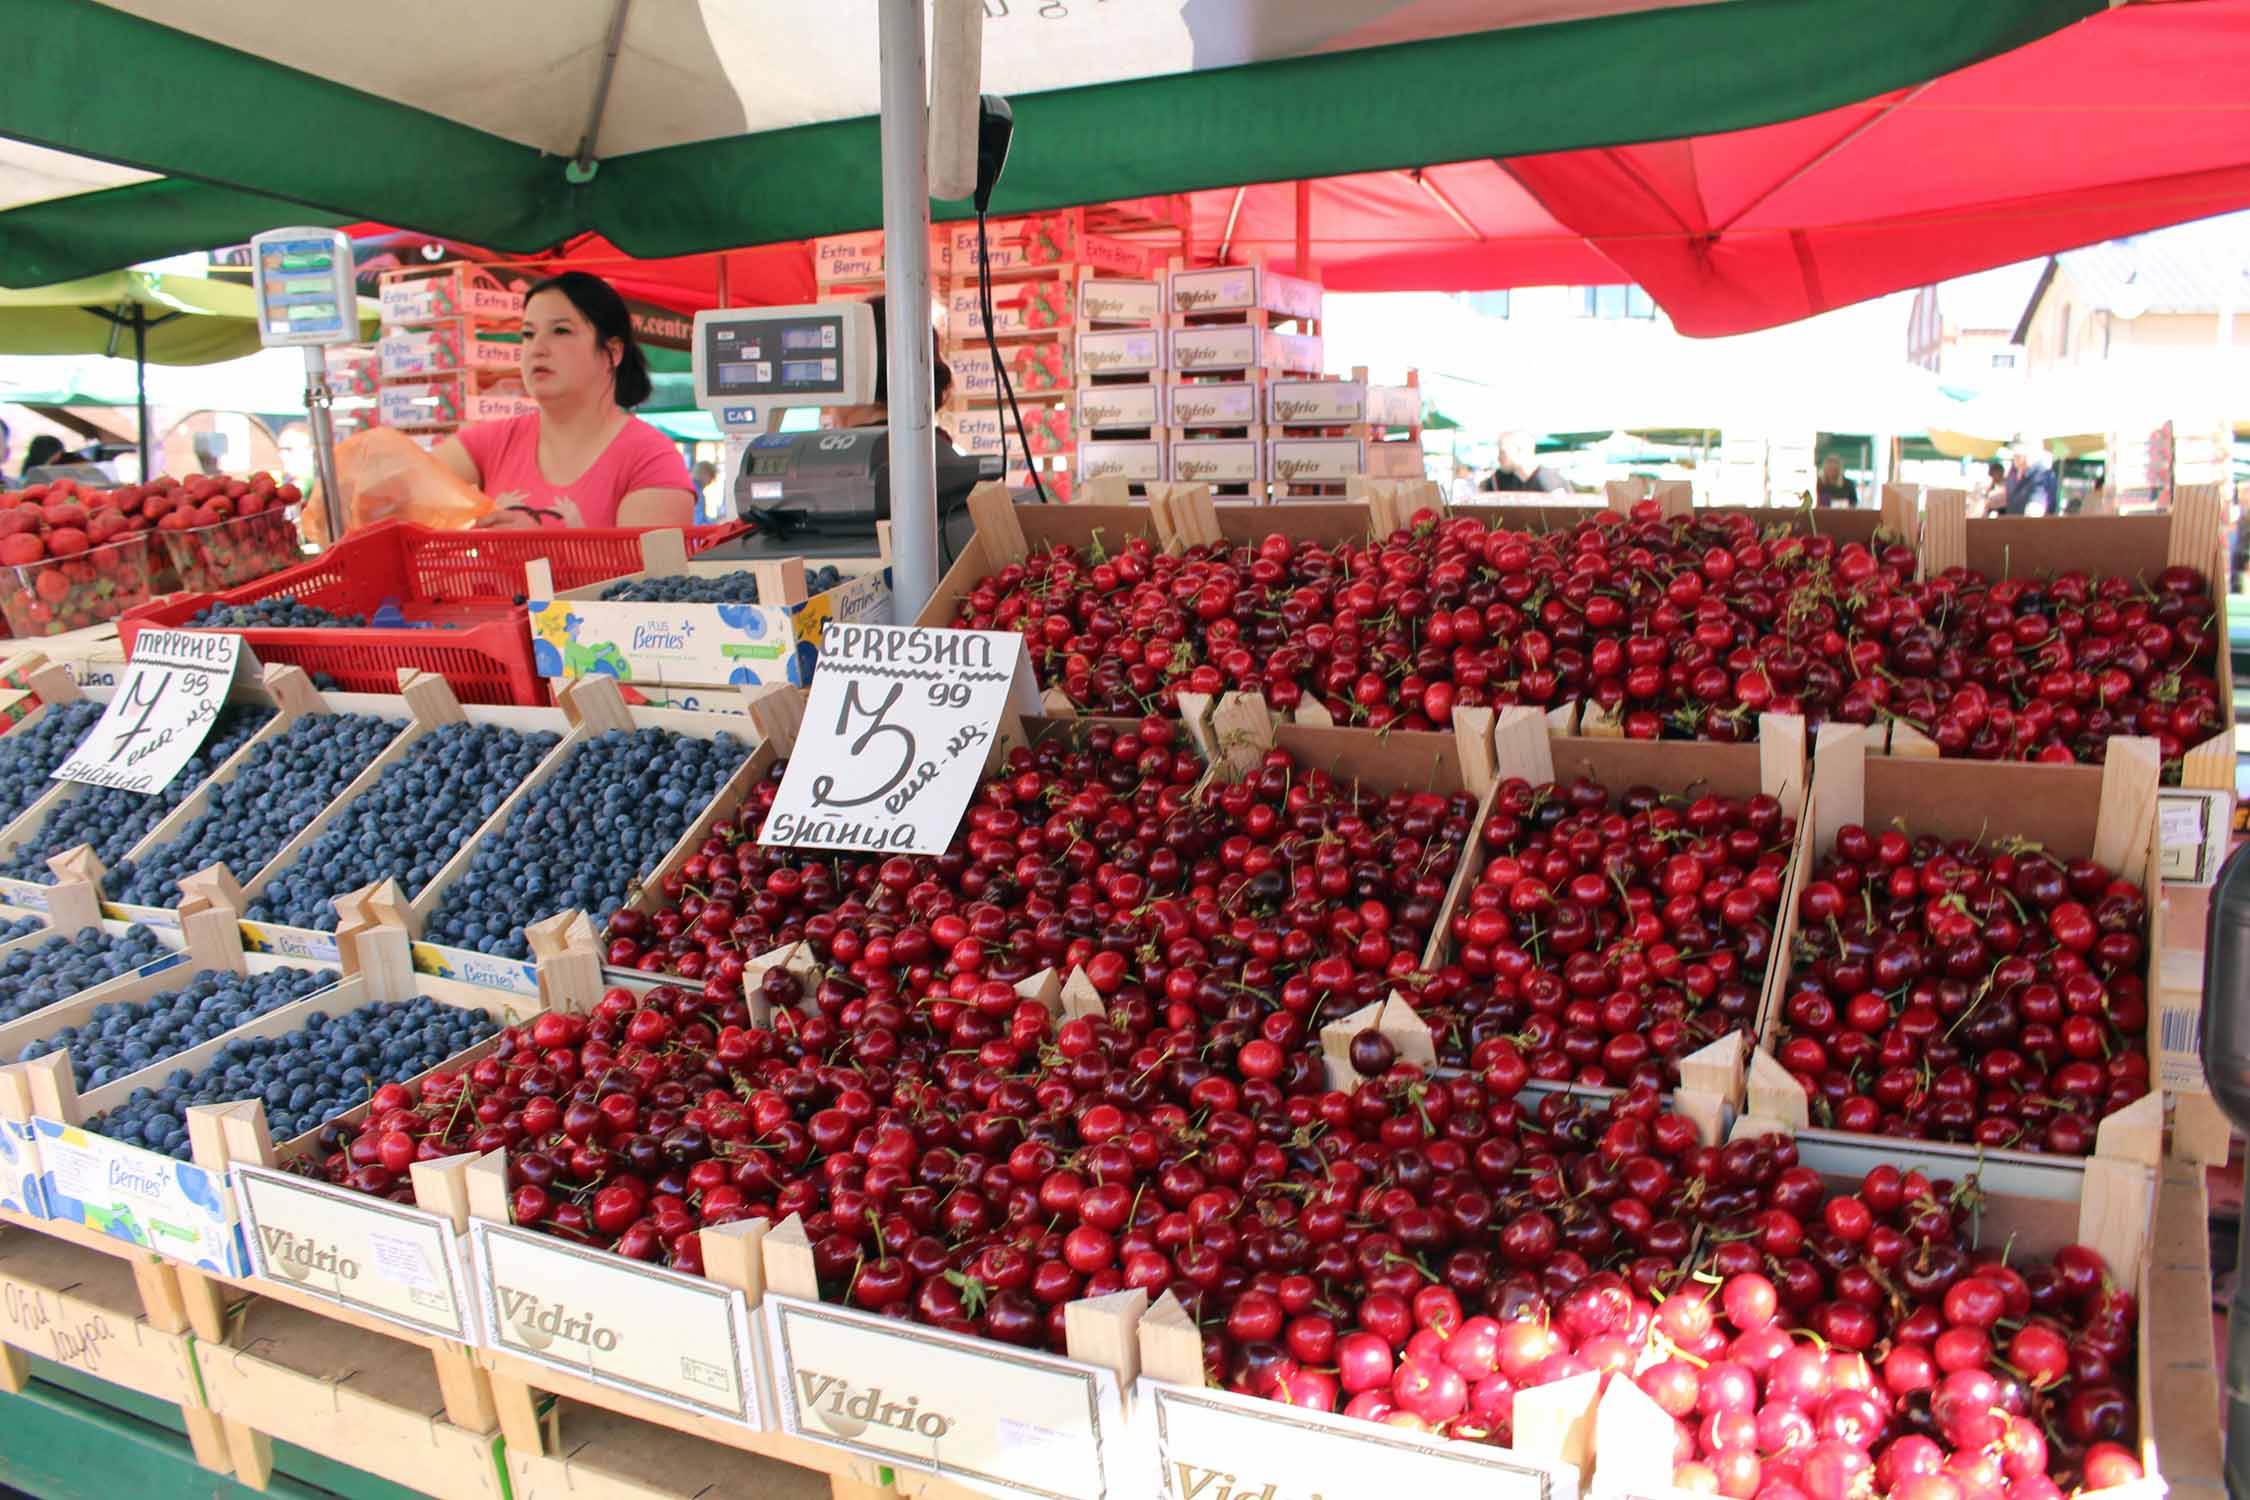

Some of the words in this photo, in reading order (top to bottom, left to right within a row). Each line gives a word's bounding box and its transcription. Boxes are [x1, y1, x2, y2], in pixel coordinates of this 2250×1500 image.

[956, 233, 992, 249] Exta
[821, 244, 855, 260] Extra
[970, 250, 1011, 266] Brry
[833, 259, 872, 274] Berry
[475, 292, 508, 310] Extra
[1176, 291, 1217, 305] Vidrio
[477, 344, 510, 361] Extra
[952, 359, 989, 374] Extra
[479, 401, 511, 414] Extra
[1175, 404, 1216, 417] Vidrio
[1275, 400, 1320, 414] Vidrio
[959, 419, 995, 433] Extra
[1177, 460, 1218, 474] Vidrio
[1276, 460, 1320, 473] Vidrio
[632, 624, 685, 651] Berries
[928, 682, 972, 708] 99
[109, 1159, 162, 1198] Berries
[259, 1224, 359, 1280] Vidrio
[496, 1285, 618, 1352] Vidrio
[795, 1368, 950, 1438] Vidrio
